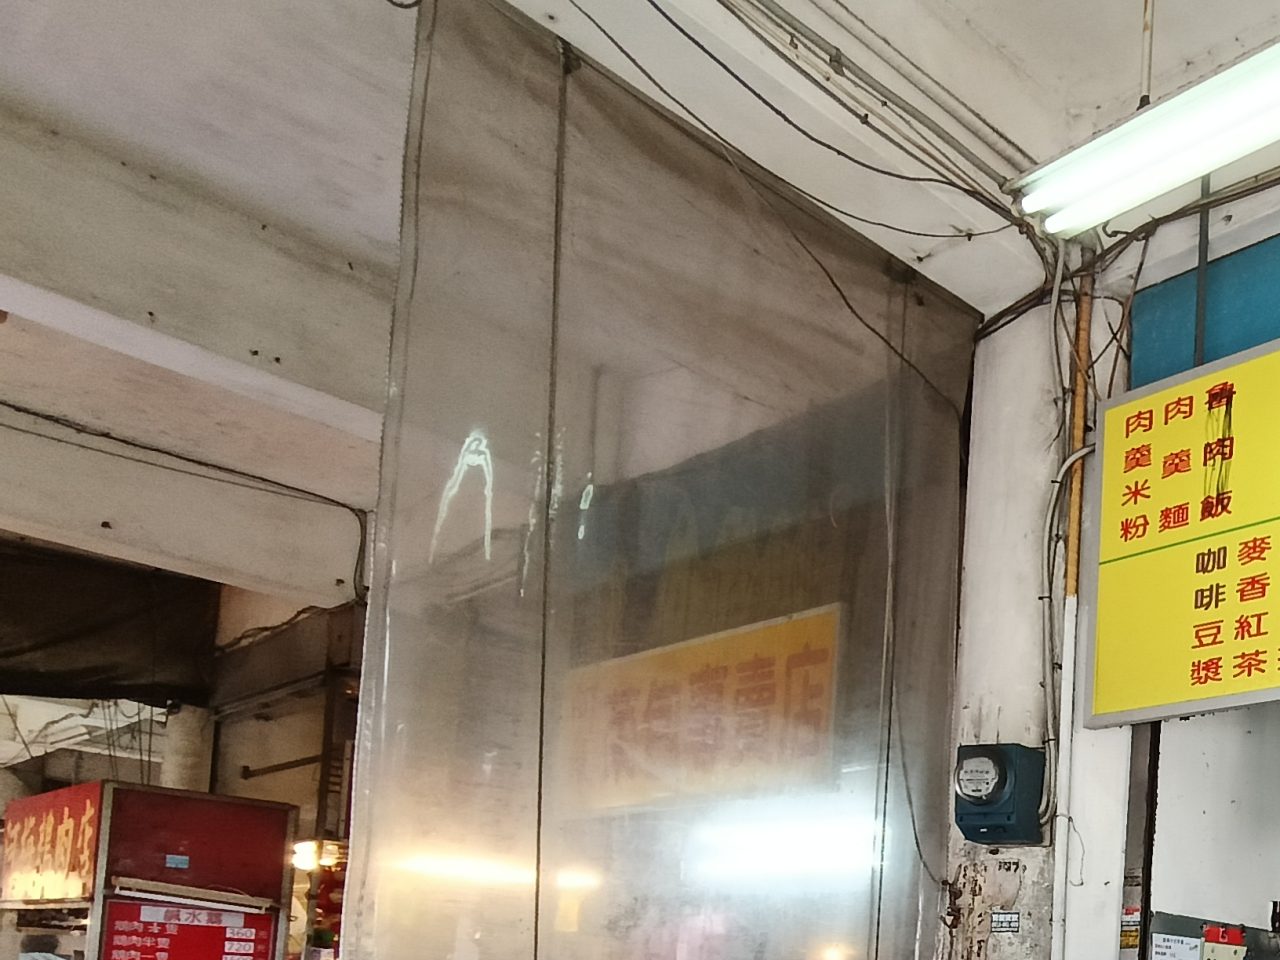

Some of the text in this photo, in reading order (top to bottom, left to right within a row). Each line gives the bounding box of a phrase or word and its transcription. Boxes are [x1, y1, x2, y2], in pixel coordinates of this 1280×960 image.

[1120, 409, 1153, 542] 肉羹米粉
[1159, 396, 1193, 533] 肉羹麵
[1191, 546, 1227, 686] 咖啡豆漿
[1233, 536, 1271, 678] 麥香紅茶
